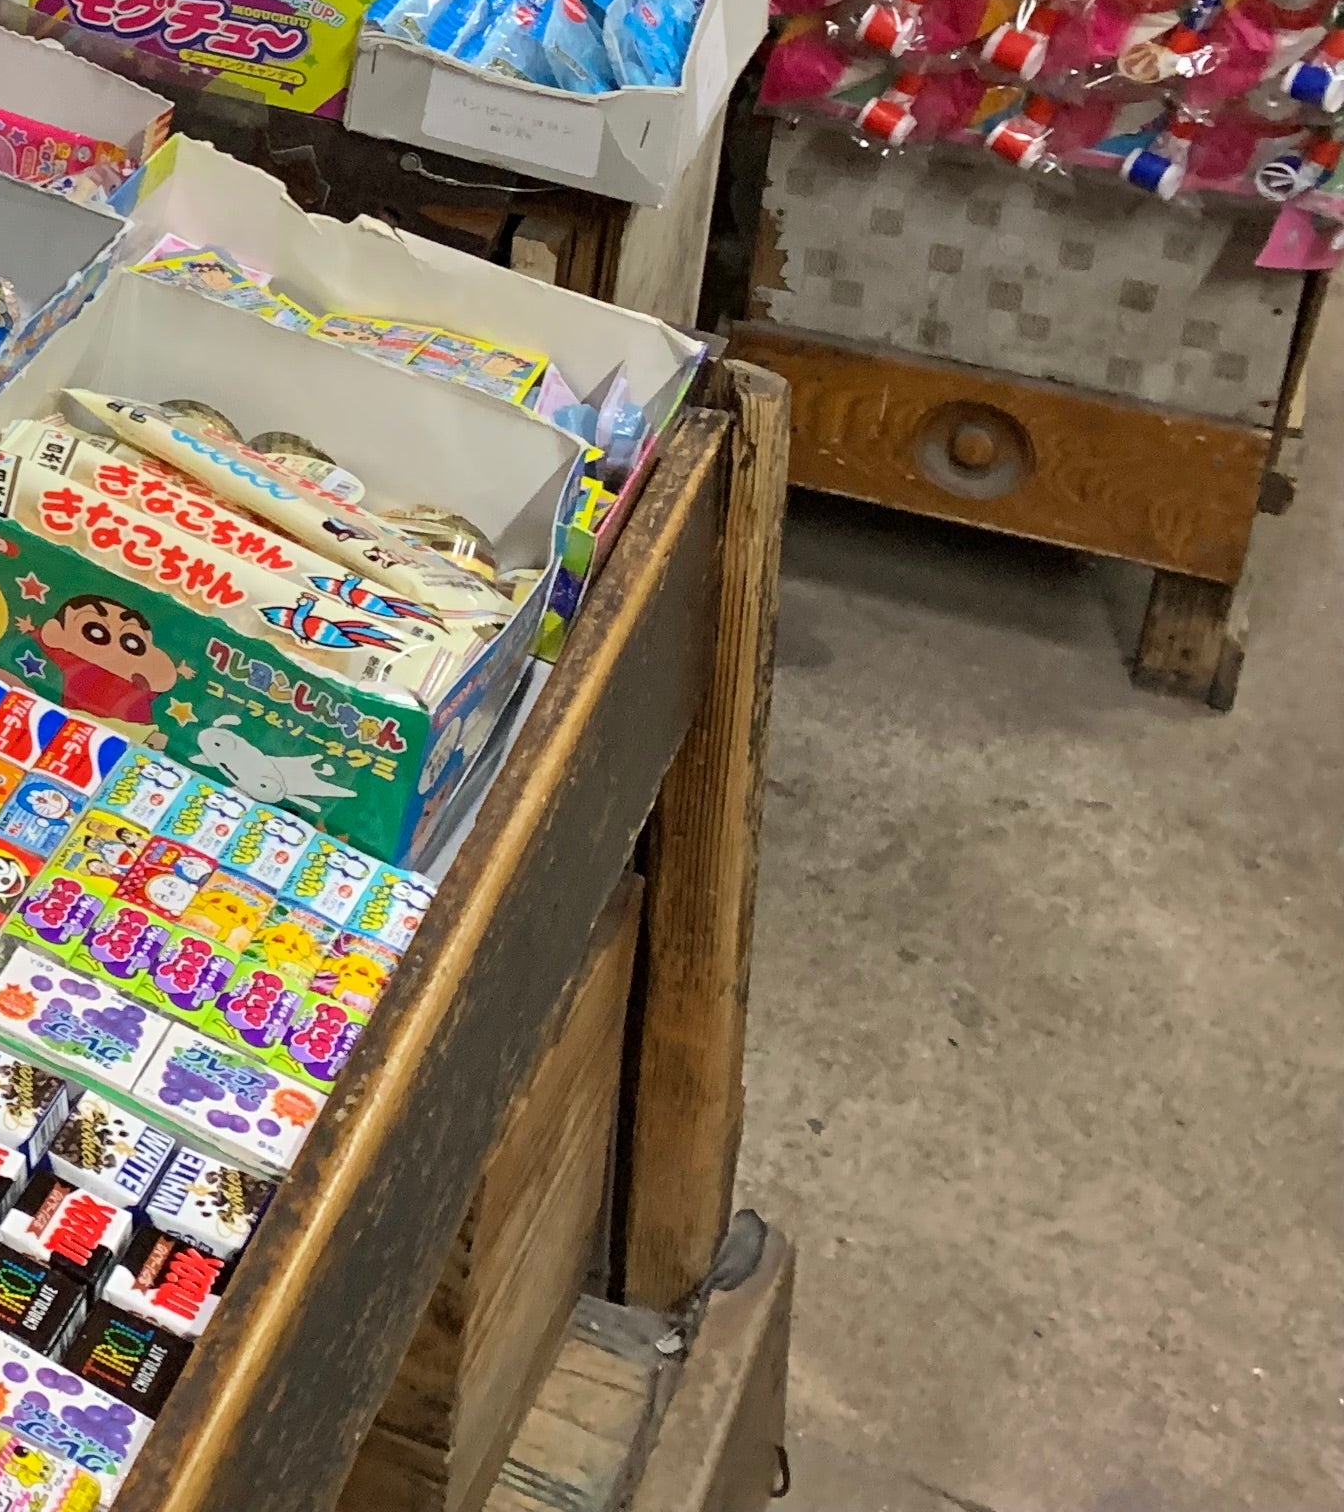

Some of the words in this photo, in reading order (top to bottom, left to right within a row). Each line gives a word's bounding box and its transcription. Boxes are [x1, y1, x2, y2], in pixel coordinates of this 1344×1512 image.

[38, 484, 248, 609] きなこちゃん
[93, 461, 296, 573] きなこちゃん
[205, 640, 409, 753] クレヨンしんちゃん
[45, 722, 96, 776] コーラガム
[205, 681, 399, 784] コーラ&ソーダグミ
[121, 1132, 176, 1197] WHITE
[148, 1153, 203, 1215] WHITE
[22, 1284, 59, 1332] CHOCOLATE
[82, 1318, 156, 1387] TIROL
[131, 1344, 169, 1394] CHOCOLATE
